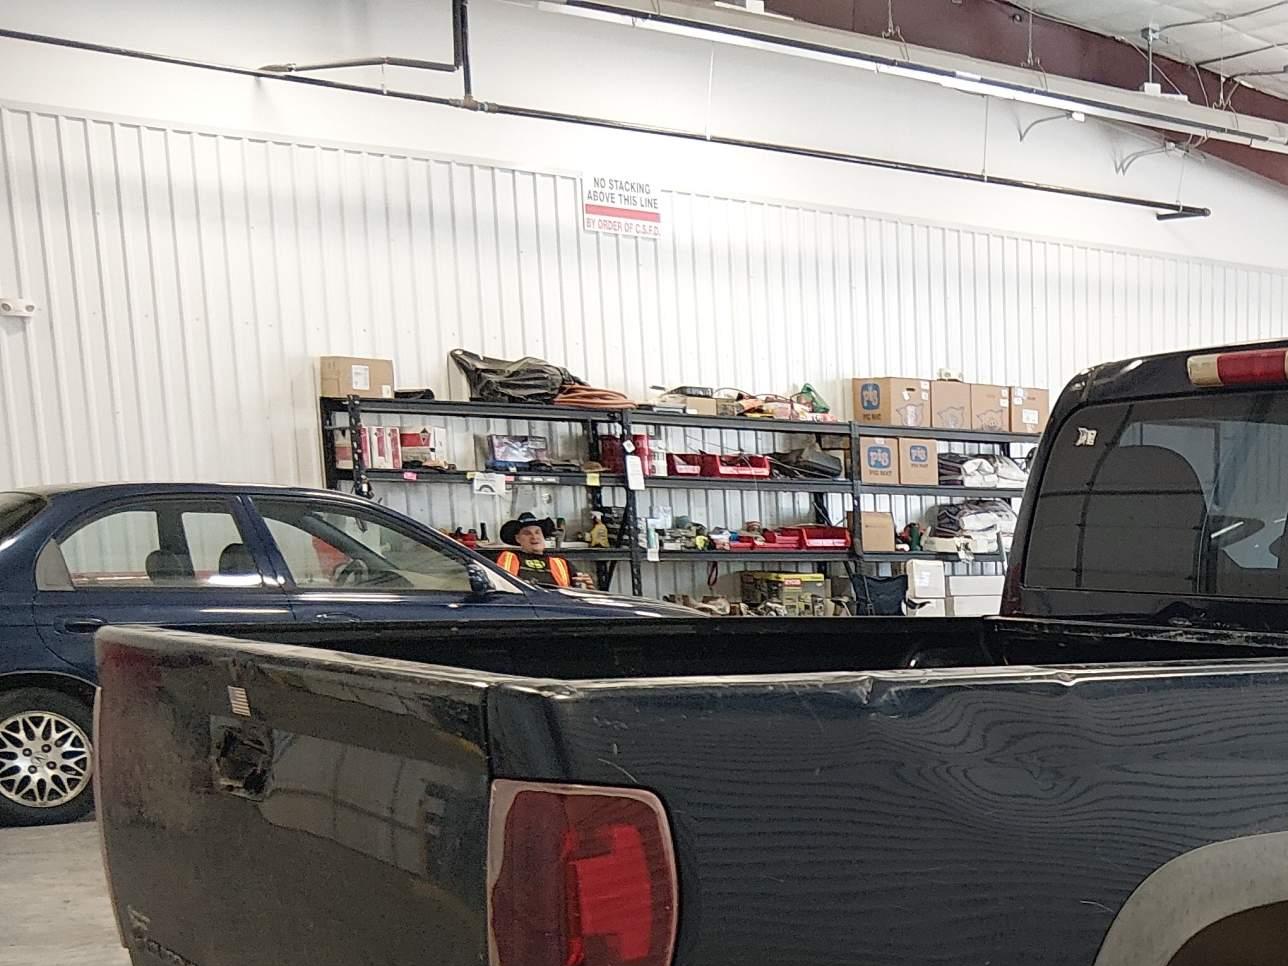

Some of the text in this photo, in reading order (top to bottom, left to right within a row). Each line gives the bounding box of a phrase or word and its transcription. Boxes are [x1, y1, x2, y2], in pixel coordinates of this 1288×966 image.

[593, 177, 651, 195] NO STACKING
[587, 190, 658, 209] ABOVE THIS LINE
[586, 217, 596, 229] BY
[597, 218, 622, 232] ORDER
[624, 222, 634, 233] OF
